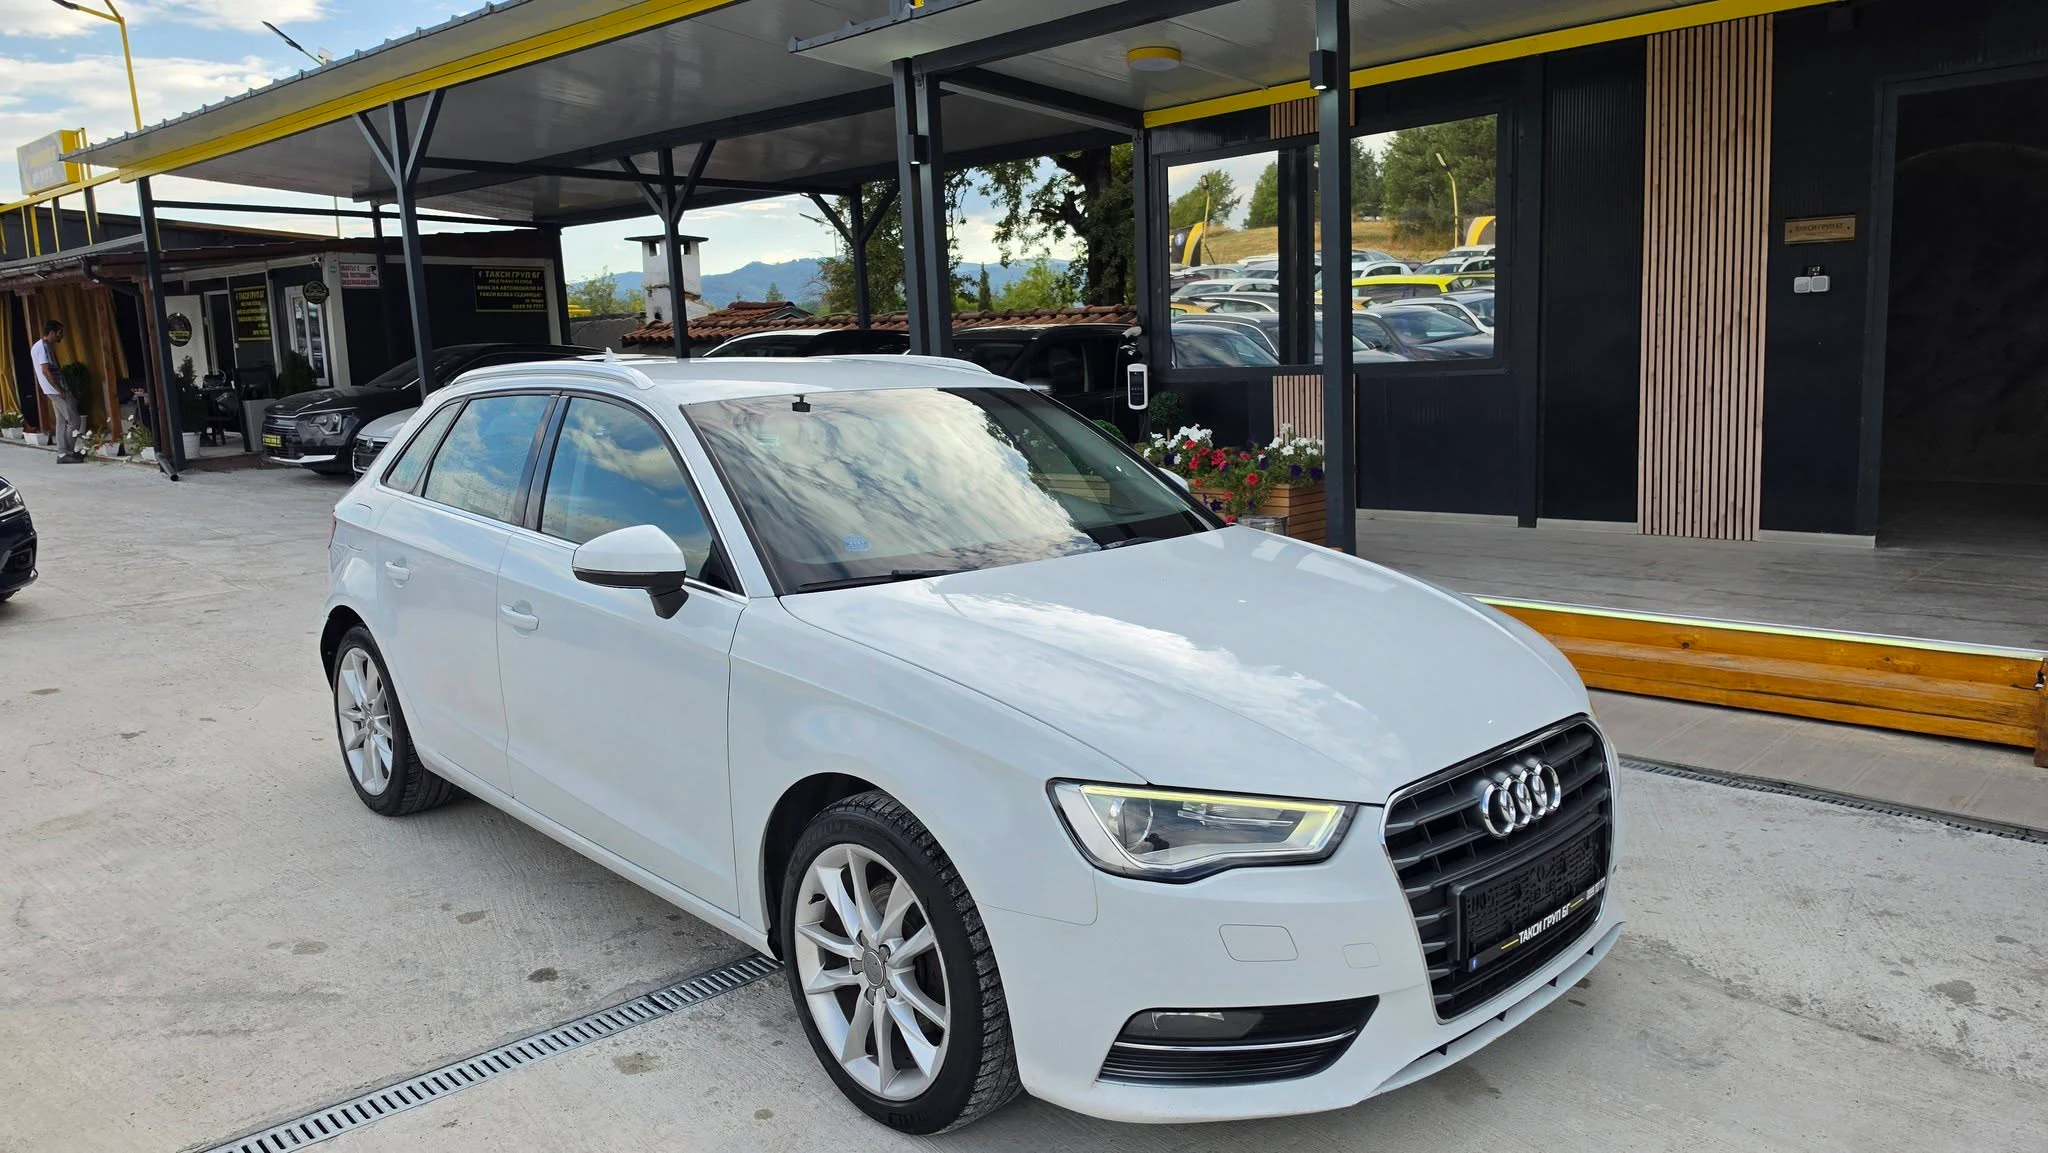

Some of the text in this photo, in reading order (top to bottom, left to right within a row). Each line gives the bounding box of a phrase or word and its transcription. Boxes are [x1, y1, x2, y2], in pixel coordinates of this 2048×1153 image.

[511, 271, 531, 279] ГРУП
[1519, 921, 1542, 944] ТАКСИ
[1543, 909, 1561, 930] ГРУП
[1562, 903, 1571, 918] БГ
